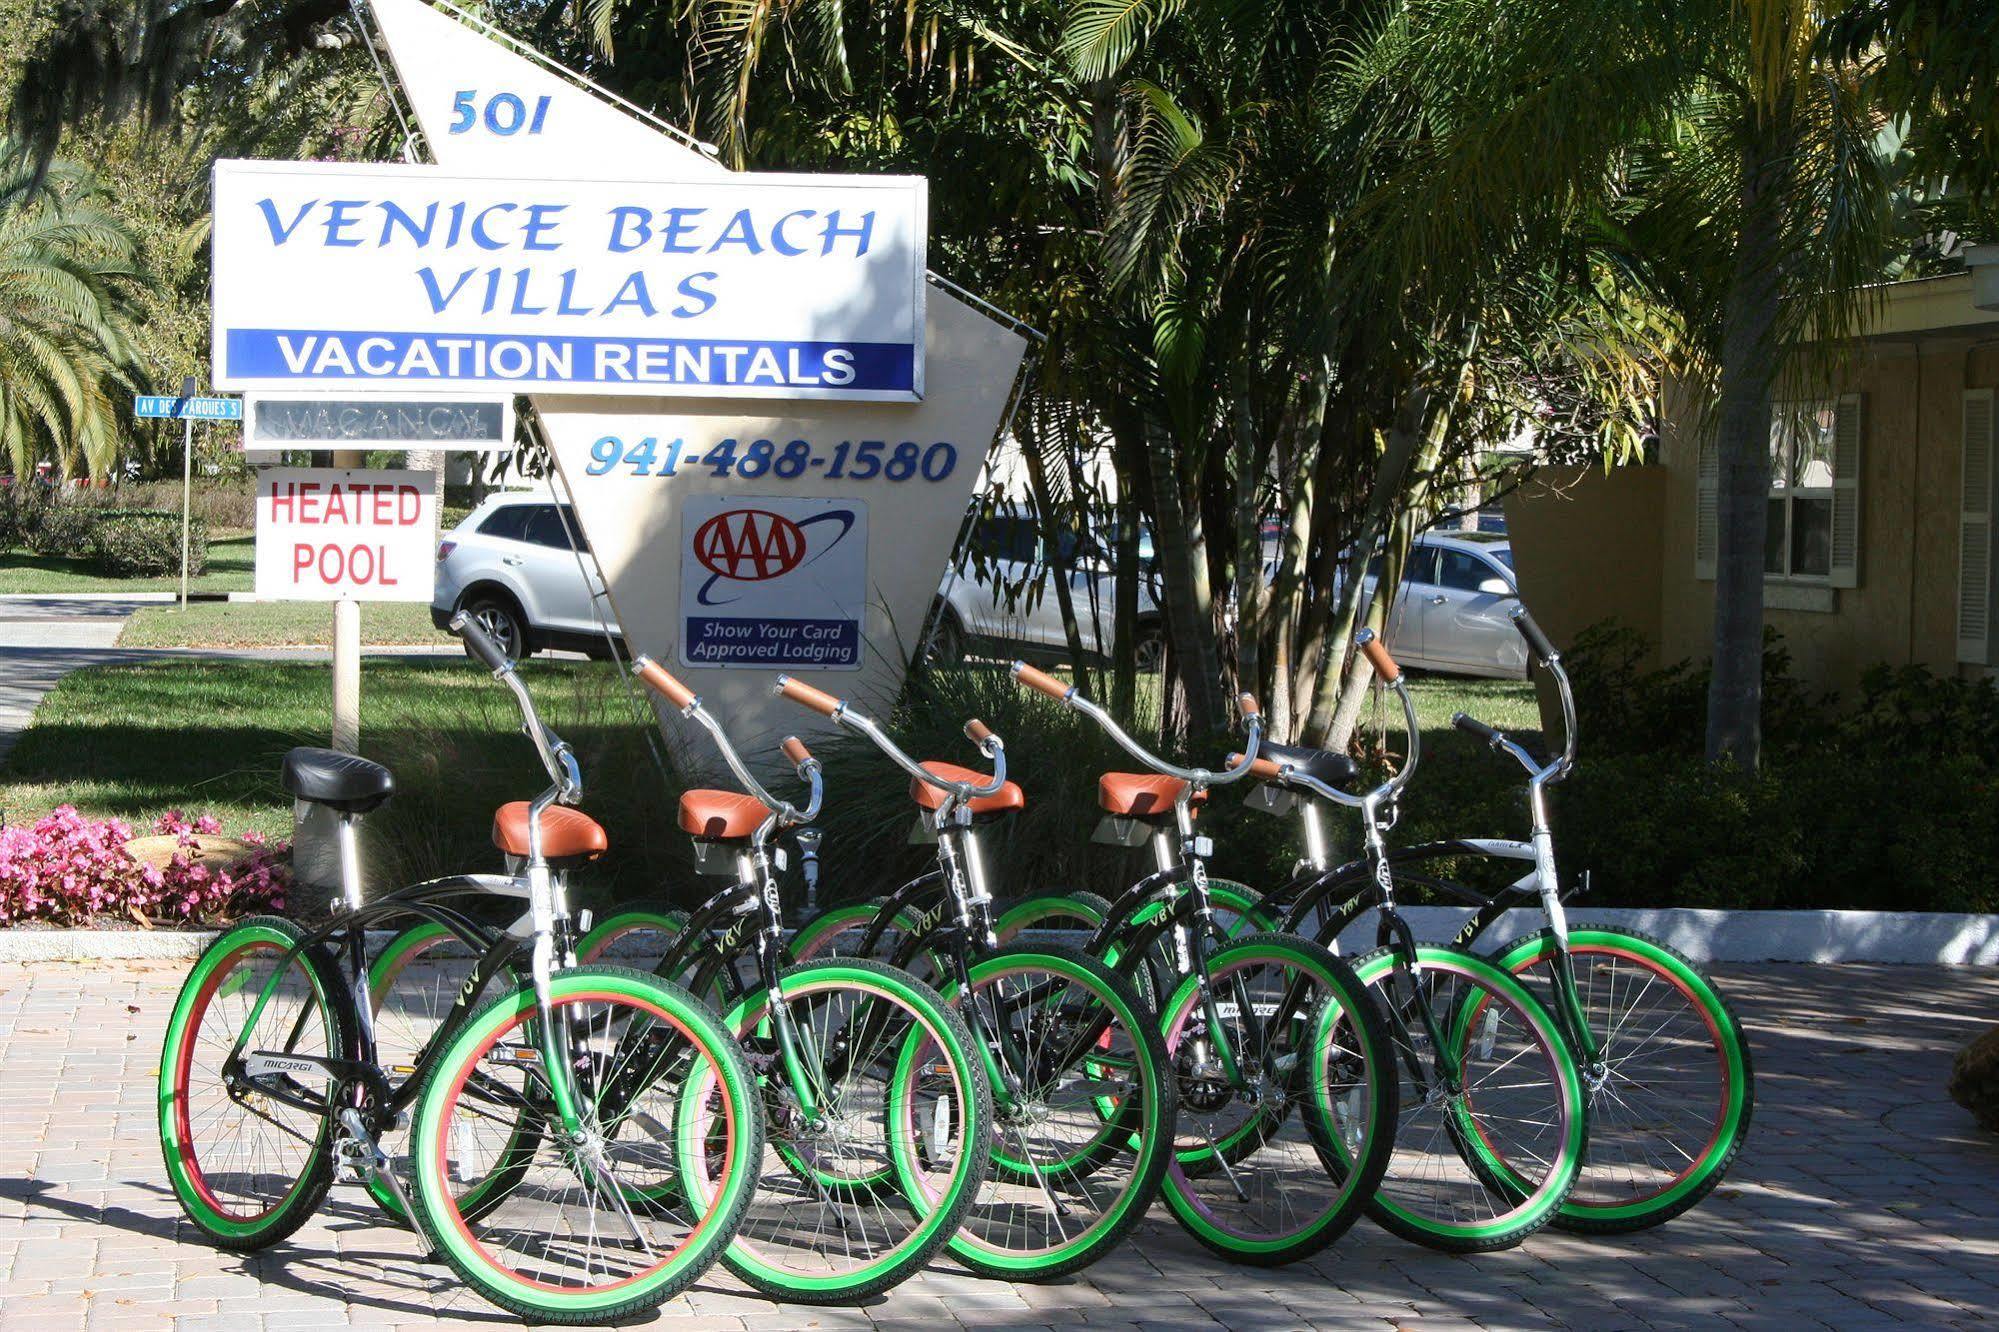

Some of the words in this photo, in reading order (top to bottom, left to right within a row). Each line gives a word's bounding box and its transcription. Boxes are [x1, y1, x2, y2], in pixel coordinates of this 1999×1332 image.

[448, 89, 552, 136] 501
[255, 198, 571, 251] VENICE
[606, 205, 876, 258] BEACH
[415, 266, 719, 319] VILLAS
[277, 335, 573, 380] VACATION
[594, 343, 856, 386] RENTALS
[141, 399, 154, 414] AV
[231, 402, 238, 416] S
[586, 435, 958, 482] 941-488-1580
[271, 481, 421, 526] HEATED
[294, 543, 398, 585] POOL
[706, 511, 792, 578] AAA
[692, 641, 780, 660] Approved
[783, 642, 852, 662] Lodging
[704, 622, 753, 638] Show
[758, 624, 798, 639] Your
[802, 624, 842, 640] Card
[263, 1059, 313, 1072] MICARGI
